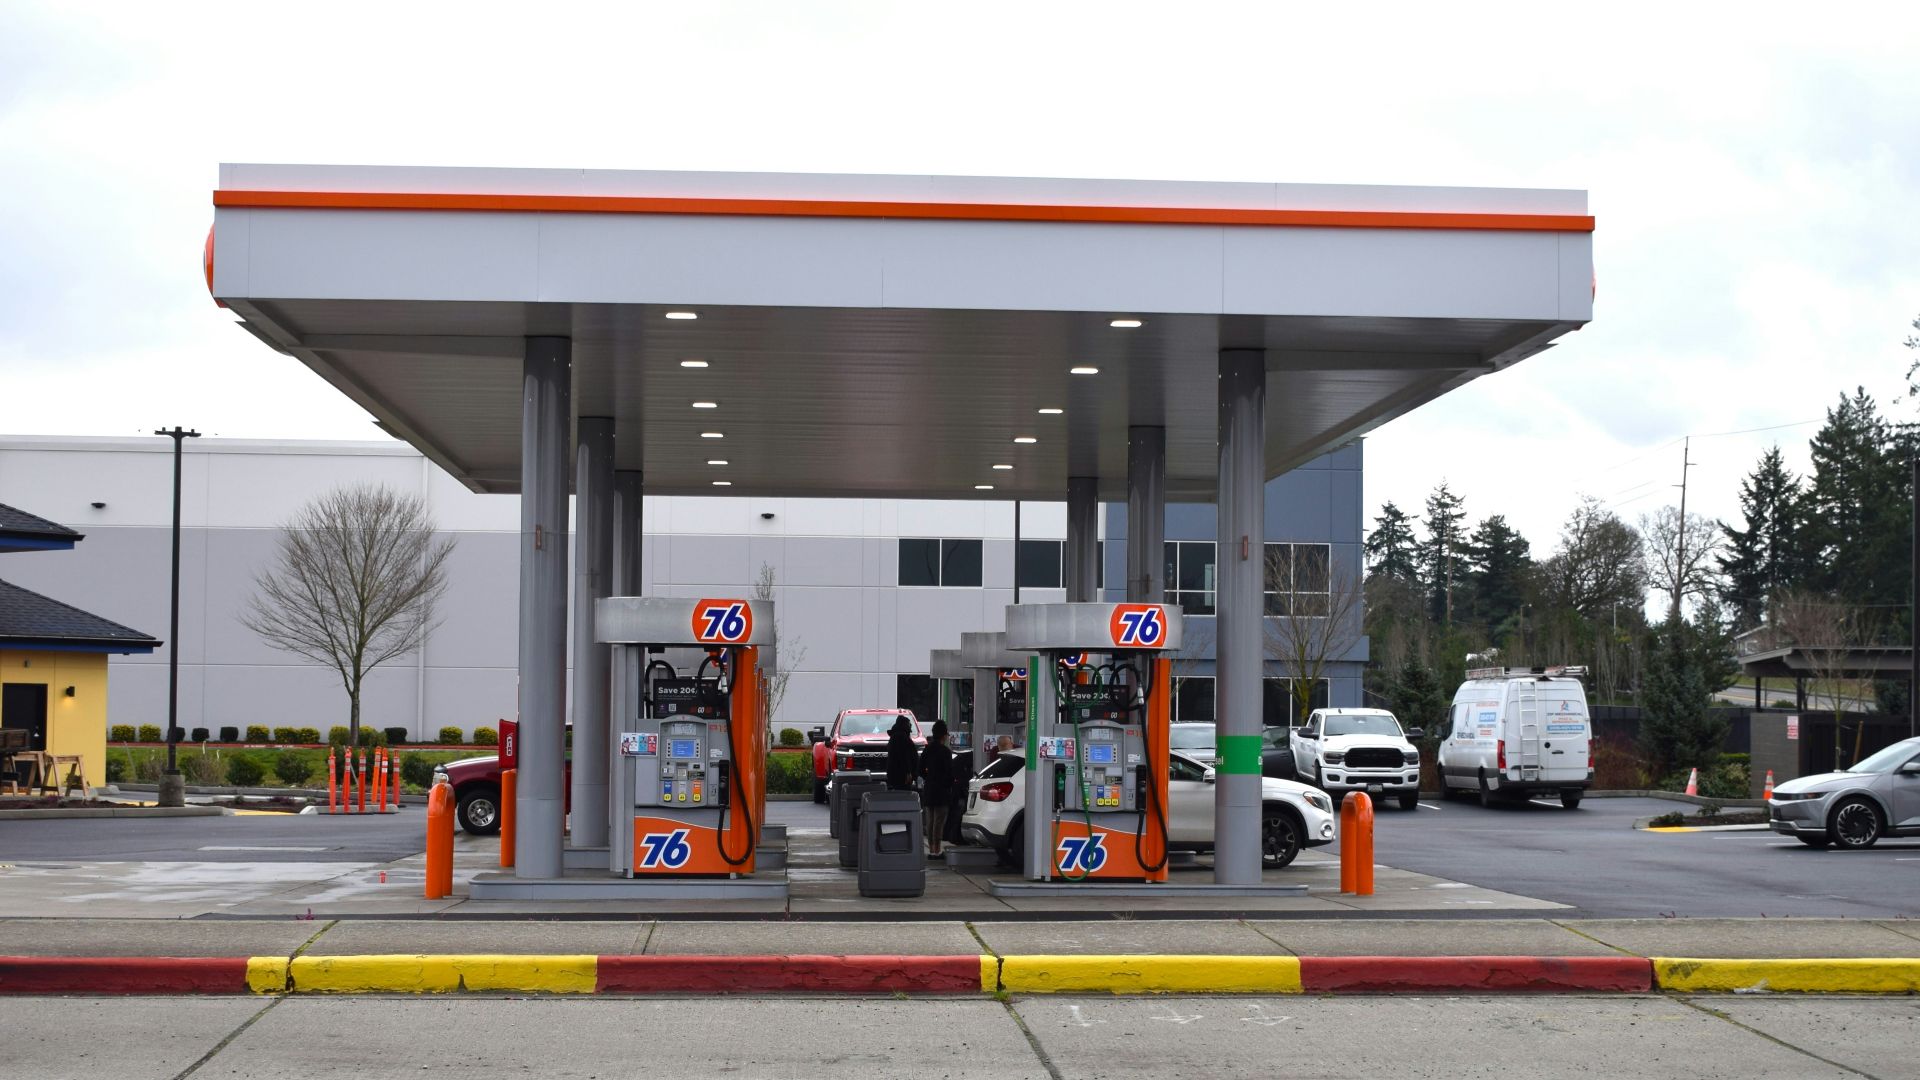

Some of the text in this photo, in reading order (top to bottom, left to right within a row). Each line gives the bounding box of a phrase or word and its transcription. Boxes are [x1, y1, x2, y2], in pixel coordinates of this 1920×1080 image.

[701, 603, 747, 641] 76
[1119, 608, 1162, 645] 76
[658, 686, 679, 694] Save
[1071, 692, 1092, 700] ave
[639, 828, 692, 869] 76
[1057, 832, 1108, 873] 76
